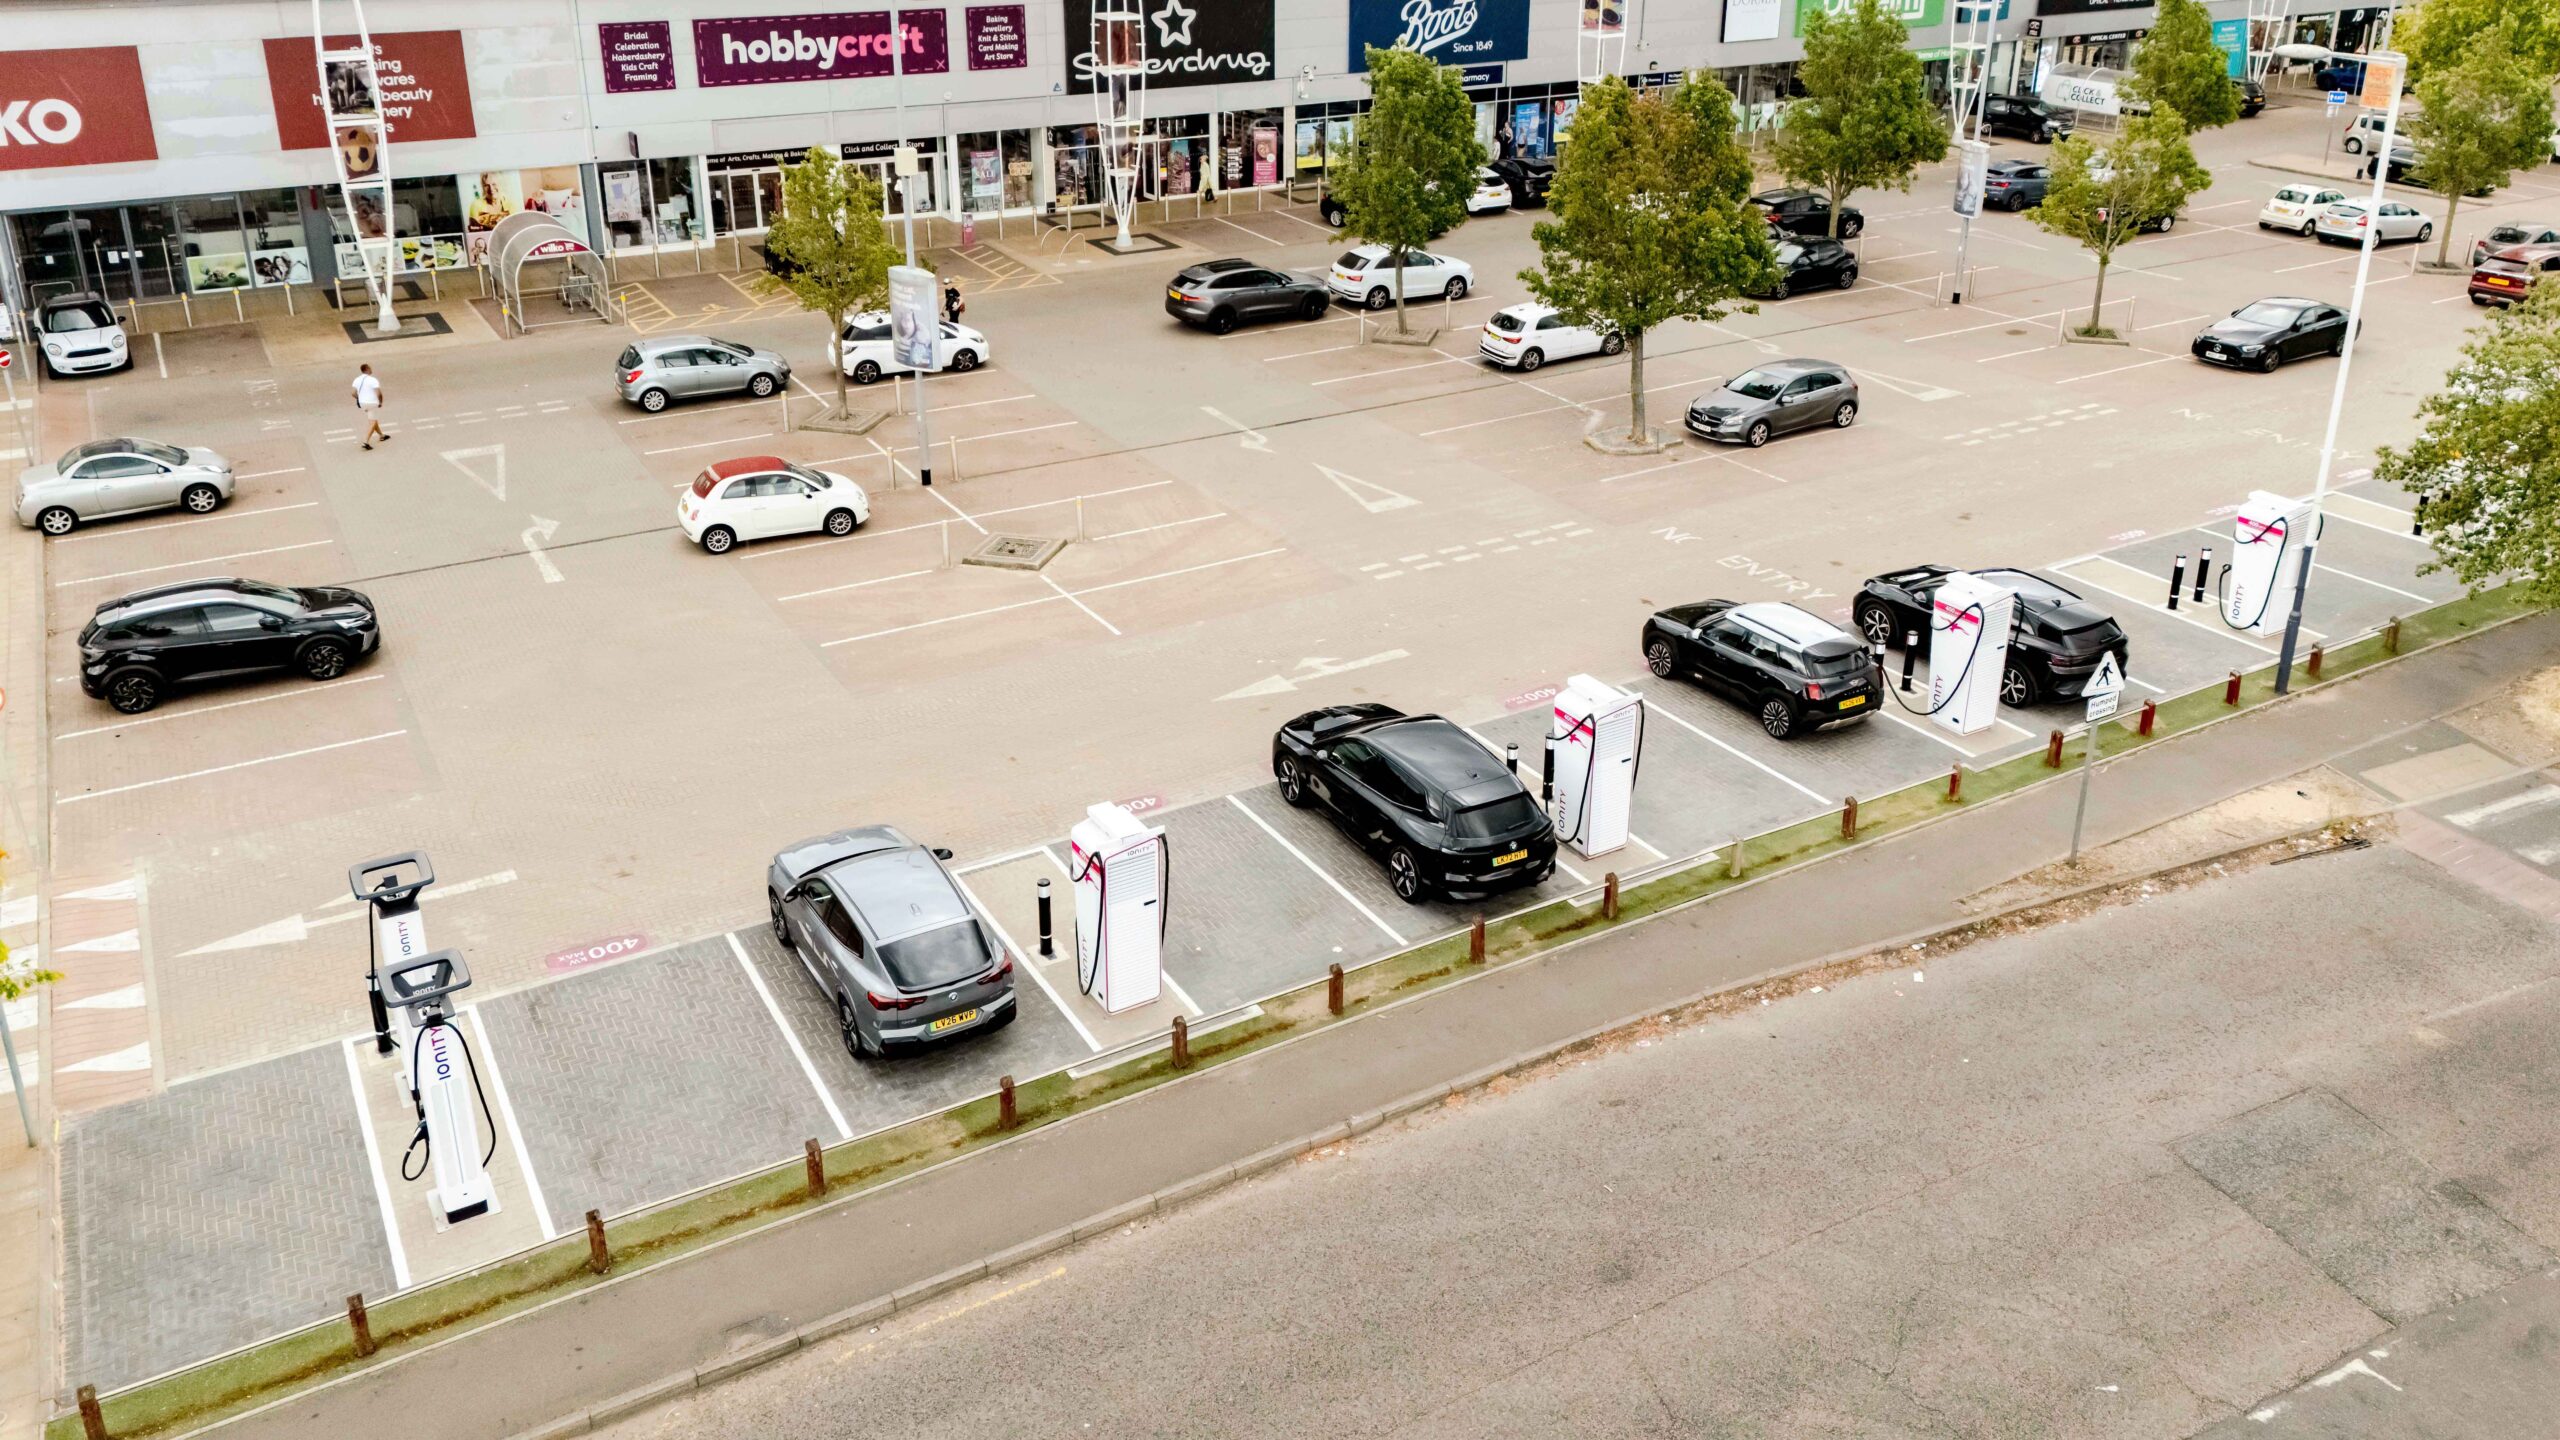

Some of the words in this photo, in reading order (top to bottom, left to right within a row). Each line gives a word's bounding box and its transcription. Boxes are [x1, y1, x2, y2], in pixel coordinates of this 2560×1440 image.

[986, 15, 1008, 23] Baking
[2352, 9, 2365, 22] JD
[982, 25, 1013, 33] Jewellery
[1397, 0, 1478, 54] Boots
[624, 31, 649, 41] Bridal
[978, 34, 992, 42] Knit
[992, 34, 999, 42] &
[999, 33, 1018, 41] Stitch
[614, 42, 660, 51] Celebration
[722, 23, 924, 70] hobbycraft
[978, 44, 994, 52] Card
[994, 43, 1019, 51] Making
[1453, 42, 1474, 53] Since
[1475, 40, 1494, 51] 1849
[611, 52, 666, 61] Haberdashery
[984, 53, 995, 61] Art
[996, 52, 1014, 60] Store
[621, 63, 638, 71] Kids
[638, 62, 659, 70] Craft
[1072, 48, 1270, 80] Serdrug
[624, 73, 658, 82] Framing
[381, 87, 433, 103] beauty
[844, 146, 860, 154] Click
[875, 143, 898, 151] Collect
[540, 243, 564, 254] wilko
[1715, 554, 1838, 600] ENTRY
[2231, 583, 2245, 620] IONITY
[1524, 687, 1557, 701] 400
[2090, 695, 2117, 708] Humped
[2088, 704, 2115, 718] crossing
[1558, 788, 1567, 833] IONITY
[1127, 846, 1150, 857] IONITY
[397, 921, 412, 956] IONITY
[588, 938, 639, 959] 400
[557, 951, 585, 962] MAX
[1081, 935, 1090, 984] IONITY
[412, 984, 437, 998] IONITY
[430, 1026, 452, 1081] IONITY
